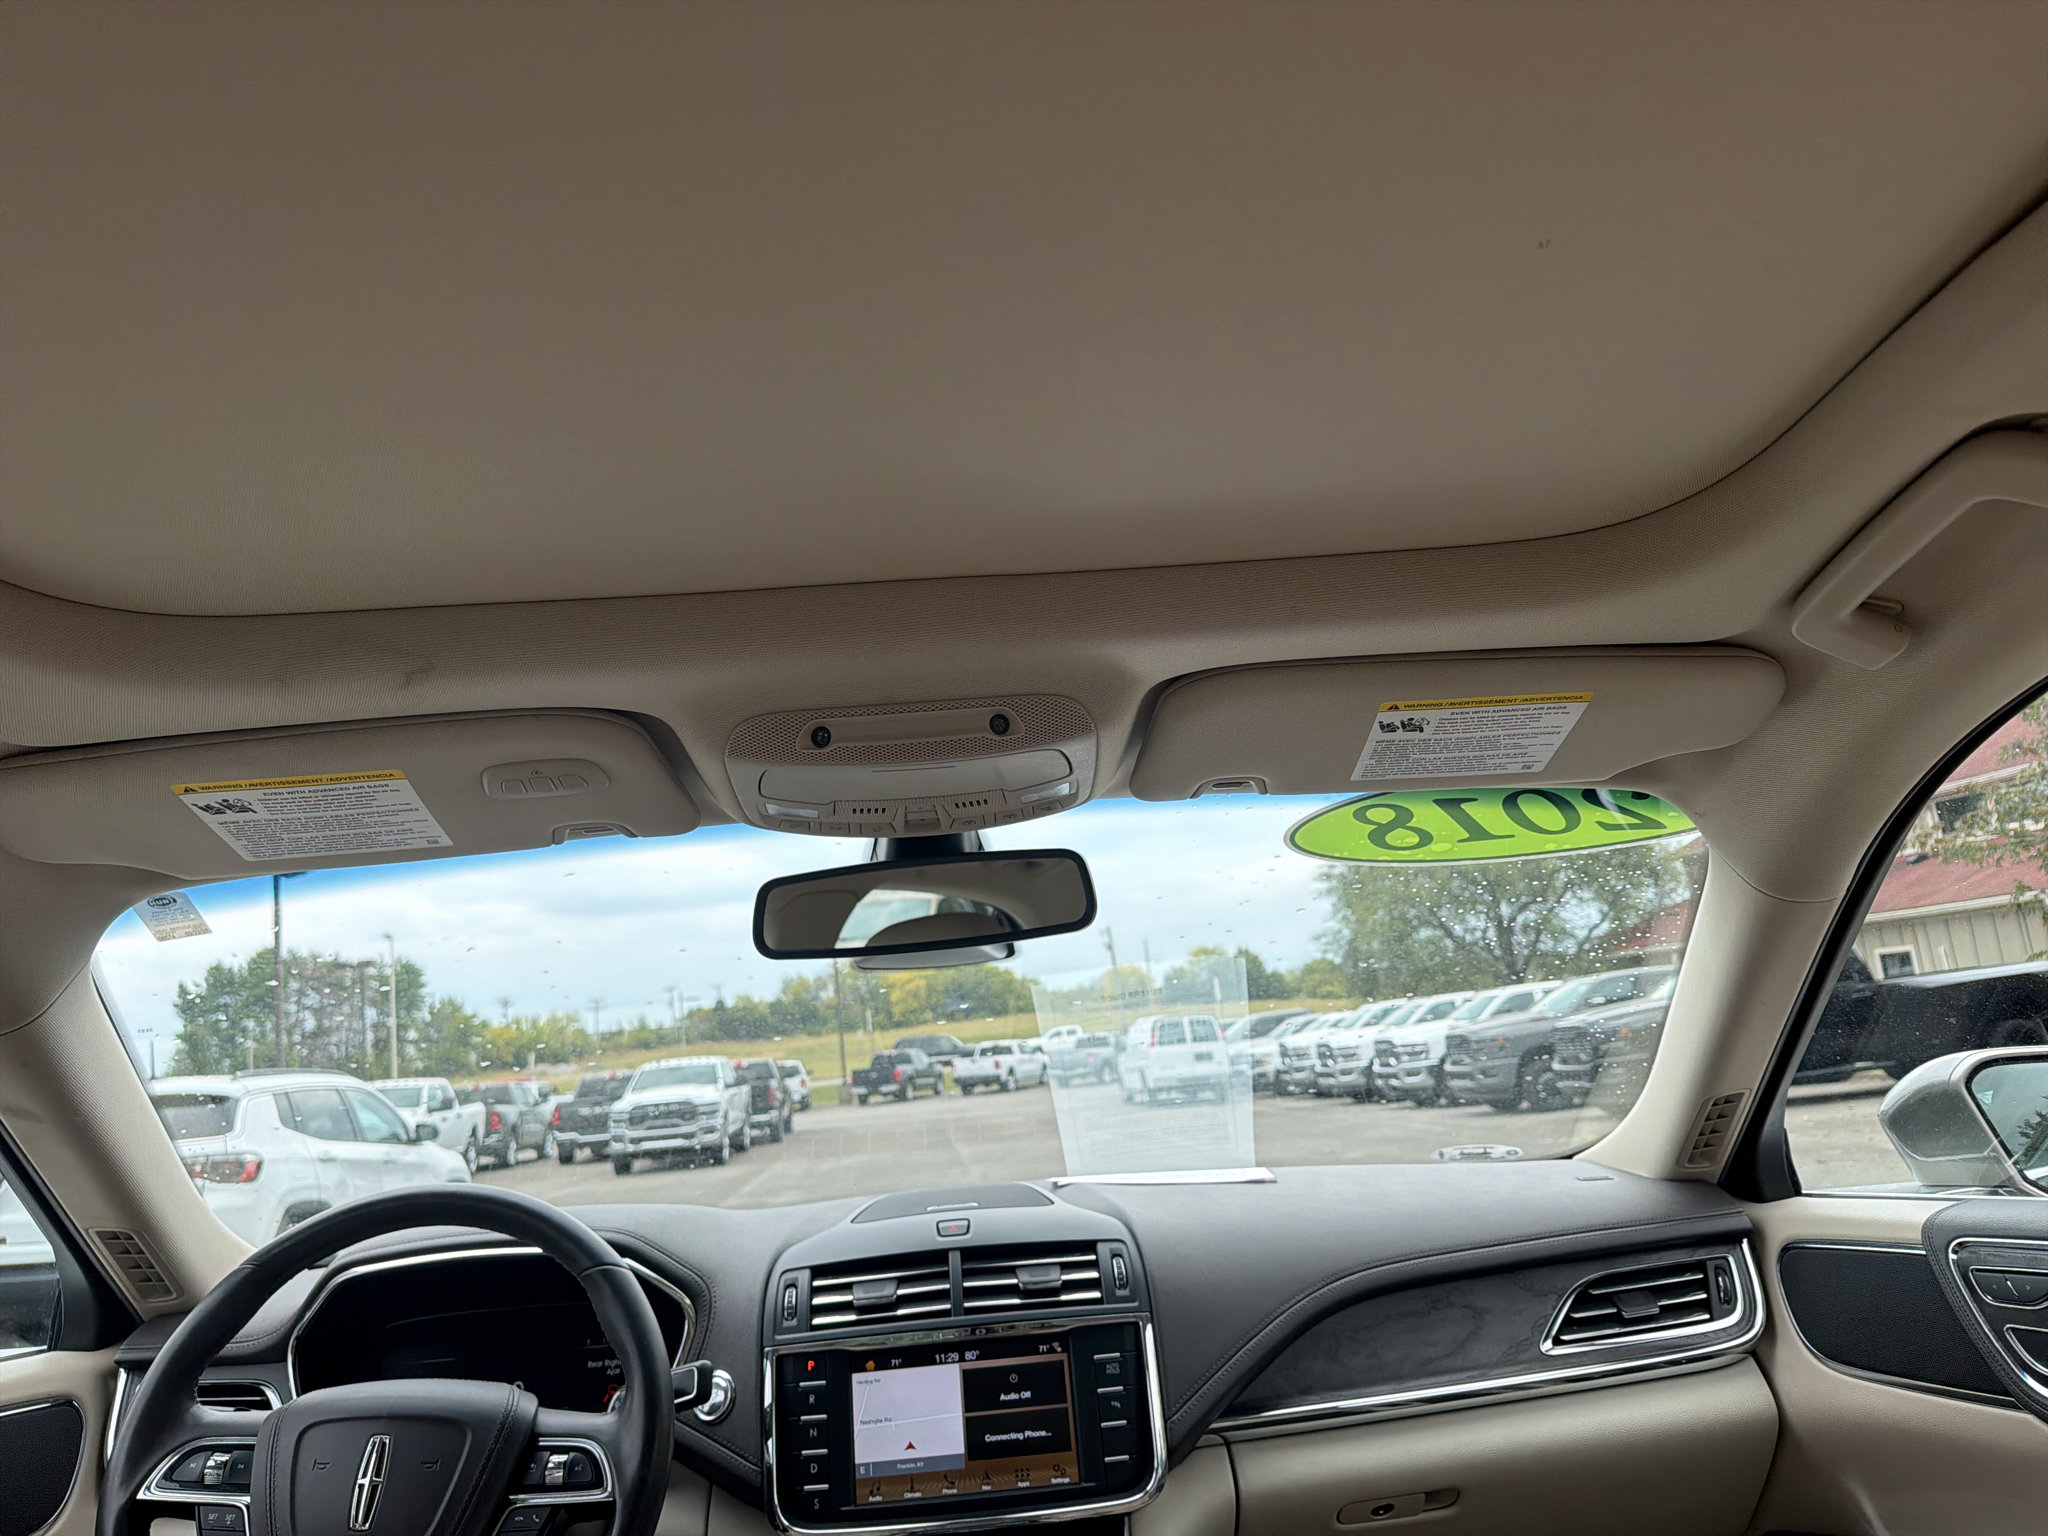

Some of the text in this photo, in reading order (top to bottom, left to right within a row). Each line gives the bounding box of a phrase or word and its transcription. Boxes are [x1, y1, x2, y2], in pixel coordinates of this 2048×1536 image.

[935, 1350, 980, 1363] 11:29 80°
[808, 1361, 815, 1371] P
[809, 1394, 815, 1404] R
[1000, 1391, 1031, 1401] Audio Off
[810, 1428, 817, 1437] N
[985, 1432, 1023, 1442] Connecting
[811, 1463, 817, 1473] D
[814, 1499, 819, 1509] S
